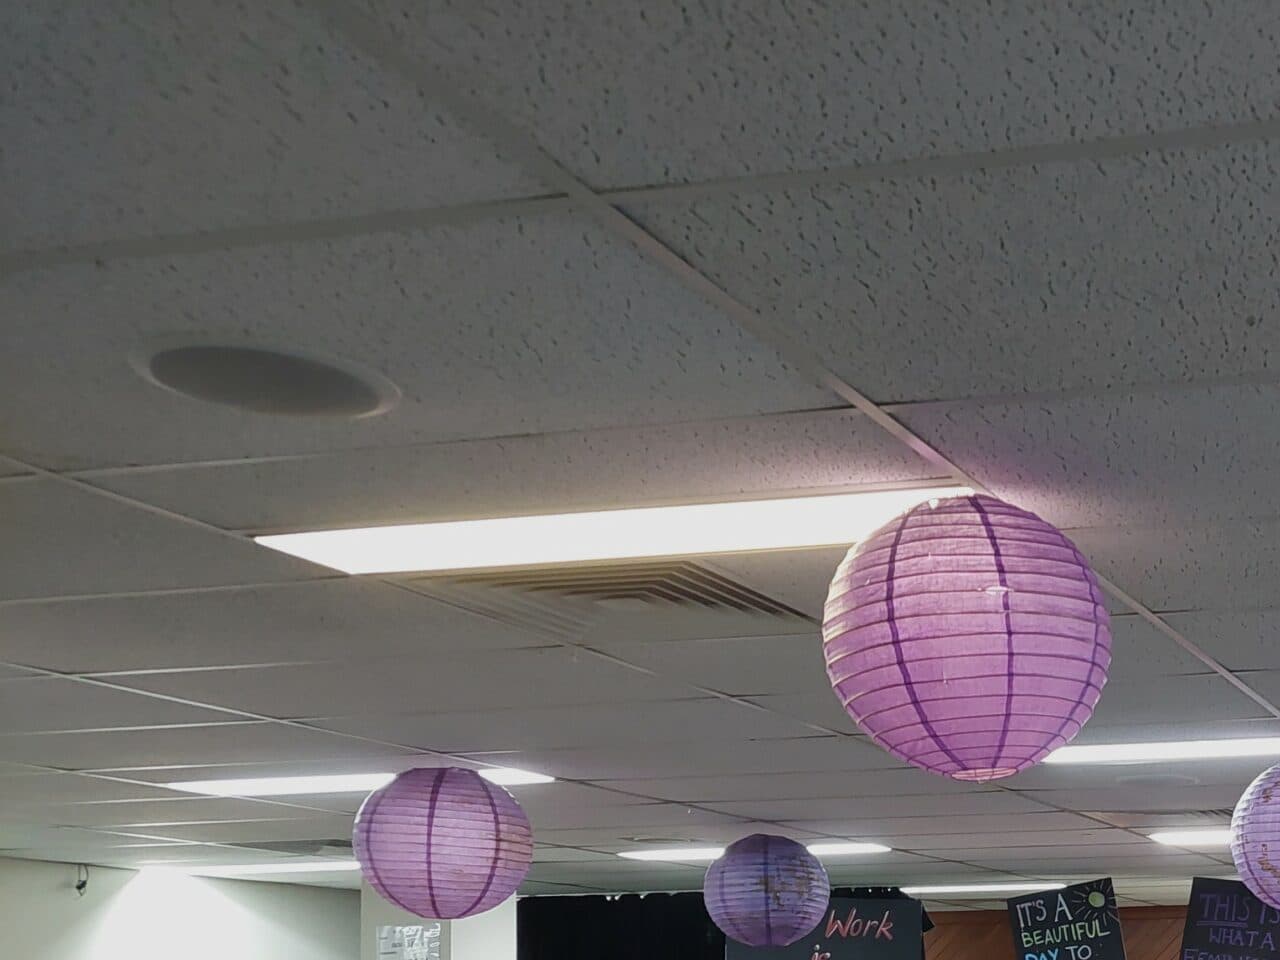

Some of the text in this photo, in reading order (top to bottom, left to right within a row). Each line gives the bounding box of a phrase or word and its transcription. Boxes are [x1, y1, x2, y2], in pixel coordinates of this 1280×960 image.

[825, 909, 893, 940] Work
[1015, 893, 1074, 931] IT'S A
[1202, 893, 1280, 925] THIS IS
[1020, 918, 1111, 949] BEAUTIFUL
[1209, 928, 1276, 951] WHAT A
